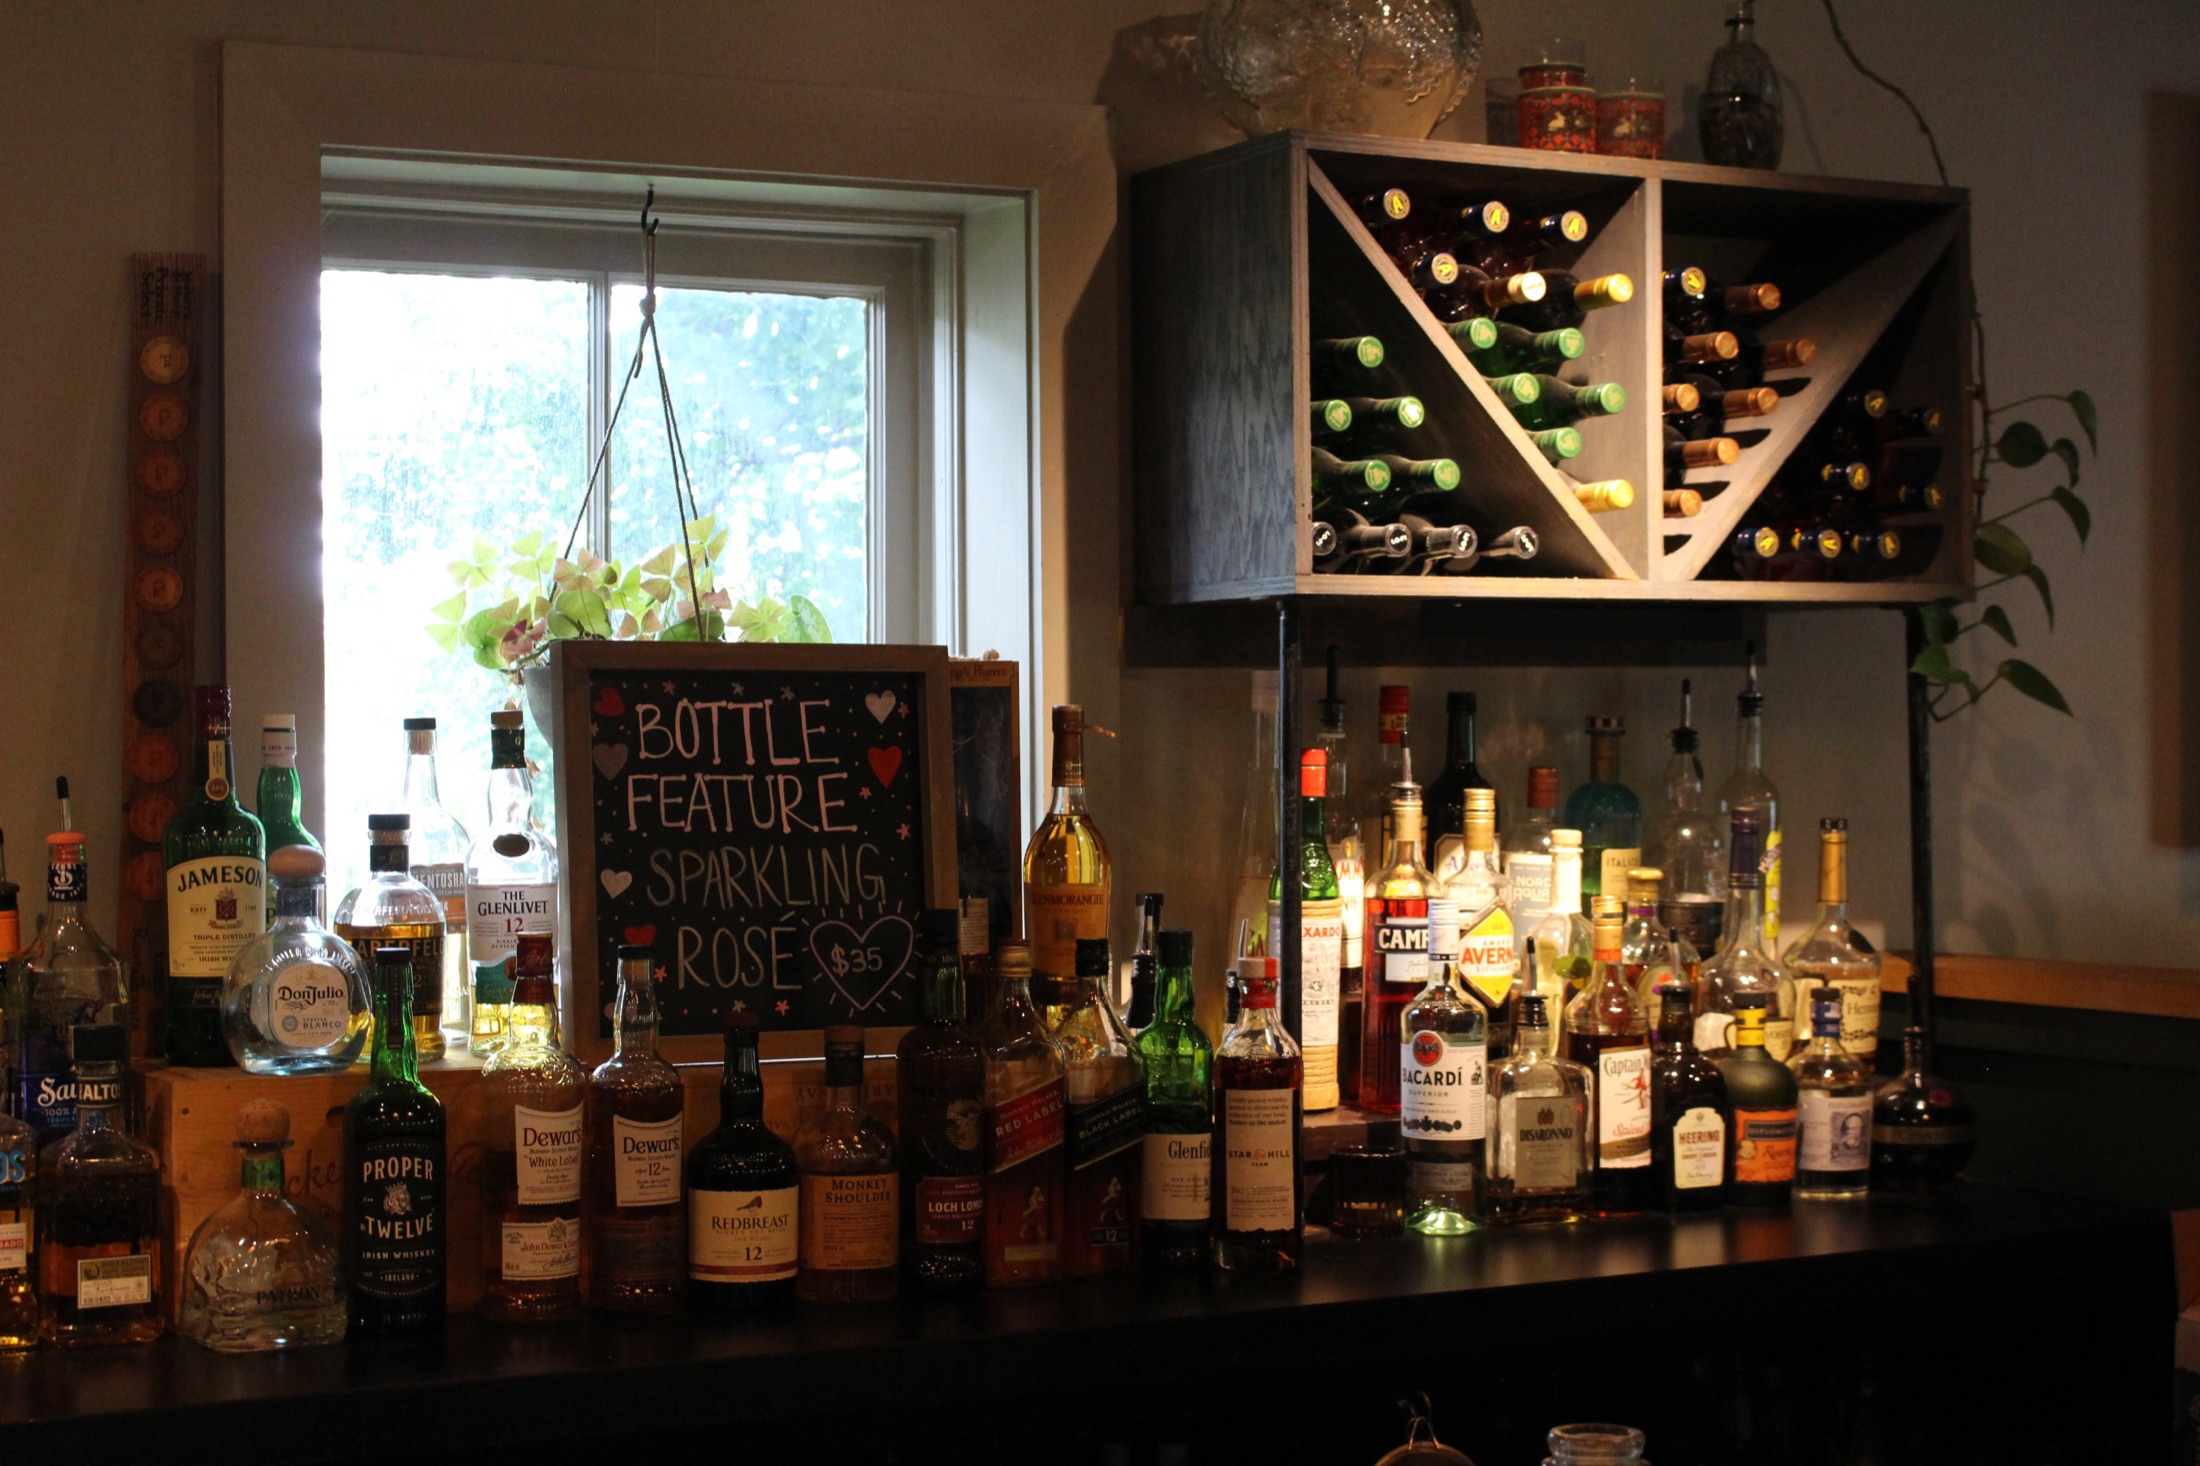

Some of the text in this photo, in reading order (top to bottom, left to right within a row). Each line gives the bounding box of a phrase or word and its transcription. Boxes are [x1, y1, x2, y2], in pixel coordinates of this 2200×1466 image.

[635, 698, 840, 765] BOTTLE
[626, 773, 858, 833] FEATURE
[177, 866, 264, 893] JAMESON
[646, 843, 886, 910] SPARKLING
[502, 890, 525, 901] THE
[477, 900, 548, 916] GLENLIVET
[505, 917, 524, 933] 12
[677, 911, 802, 991] ROSÉ
[830, 943, 884, 977] $35
[278, 985, 344, 1006] Don Julio
[303, 1021, 341, 1030] BLANCO
[1403, 1067, 1463, 1086] BACARDÍ
[36, 1076, 77, 1107] Sau
[995, 1099, 1064, 1138] RED LABEL
[1078, 1120, 1111, 1139] BLACK
[1113, 1106, 1142, 1124] LABEL
[523, 1125, 581, 1147] Dewar's
[1519, 1128, 1573, 1142] DISARONNO
[1679, 1130, 1720, 1145] HEERING
[622, 1135, 680, 1154] Dewar's
[1229, 1149, 1291, 1159] STAR HILL
[363, 1156, 434, 1183] PROPER
[647, 1162, 661, 1176] 12
[831, 1178, 887, 1191] MONKEY
[824, 1190, 891, 1203] SHOULDER
[928, 1202, 958, 1213] LOCH
[364, 1212, 433, 1240] TWELVE
[711, 1213, 790, 1230] REDBREAST
[961, 1220, 974, 1231] 12
[1105, 1230, 1118, 1243] 12
[362, 1248, 436, 1260] IRISH WHISKEY
[744, 1246, 763, 1261] 12
[384, 1271, 415, 1281] IRELAND
